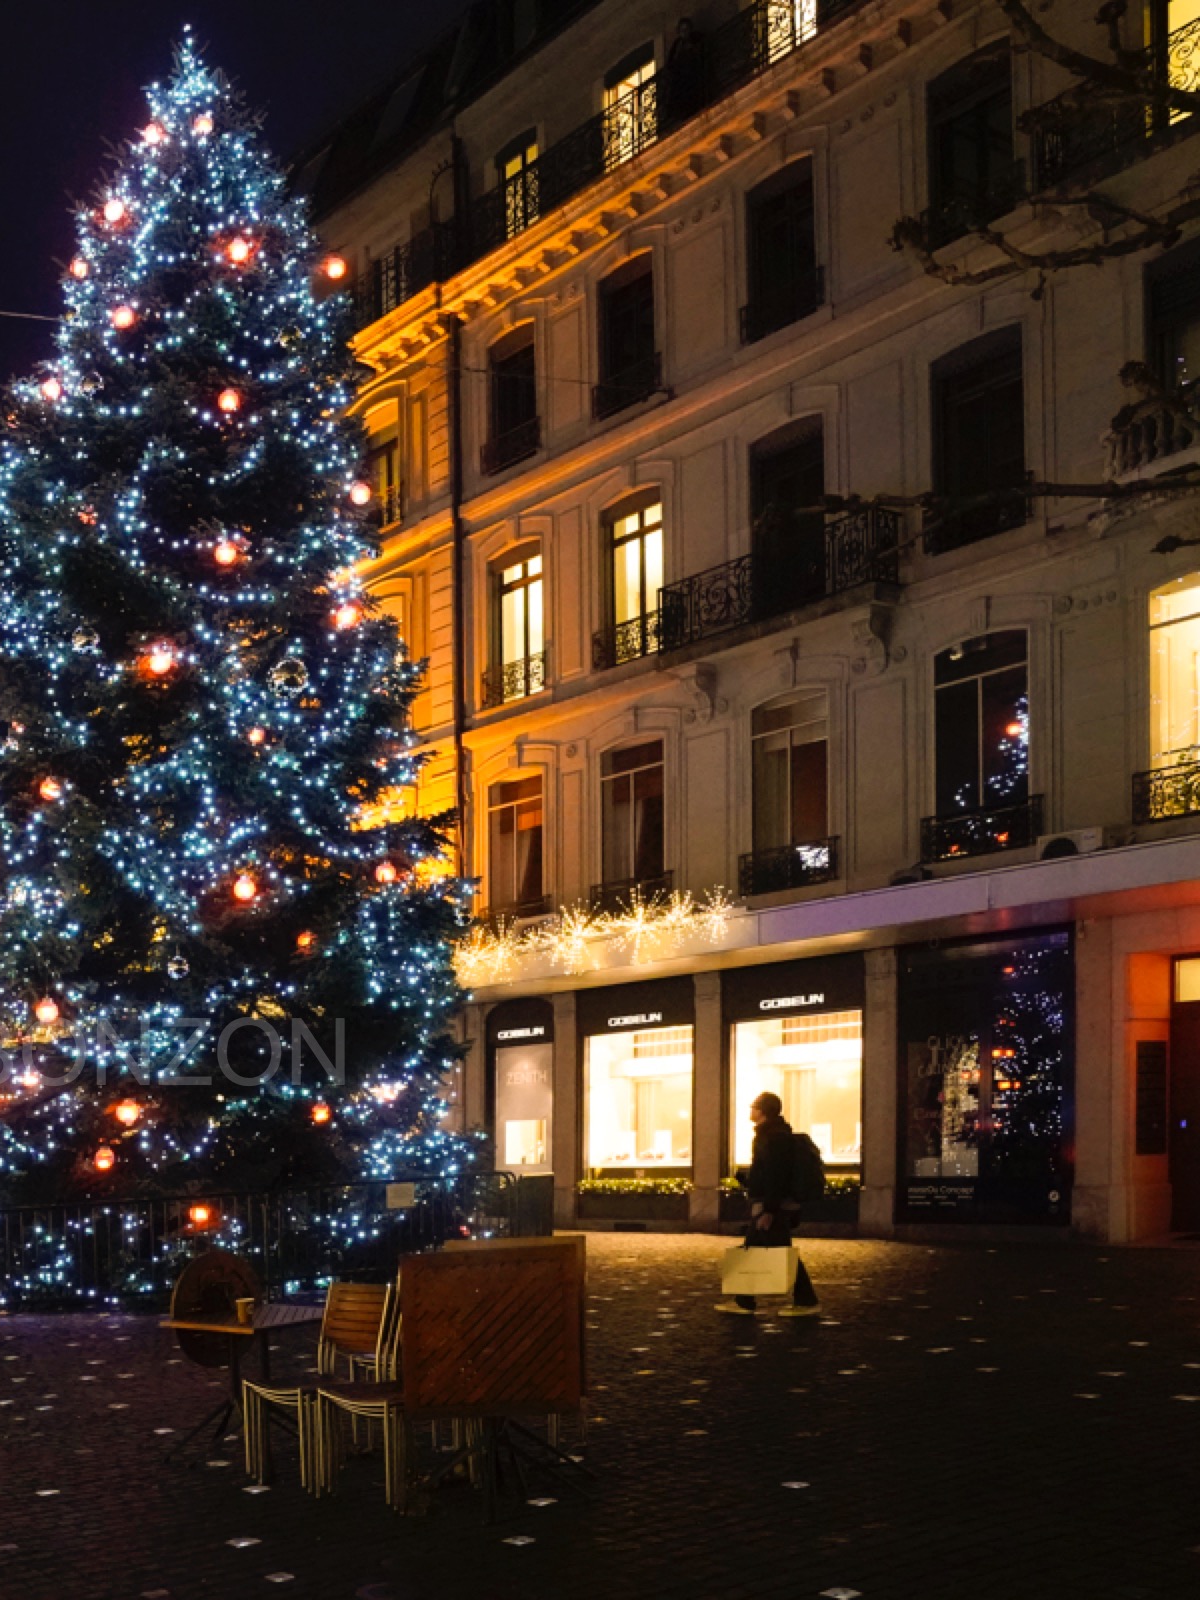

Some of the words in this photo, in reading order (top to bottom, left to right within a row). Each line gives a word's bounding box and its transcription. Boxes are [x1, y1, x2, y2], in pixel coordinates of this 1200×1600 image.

[760, 993, 824, 1011] GOBELIN
[608, 1012, 662, 1026] GOBELIN
[497, 1026, 545, 1040] GOBELIN
[506, 1070, 547, 1086] ZENITH
